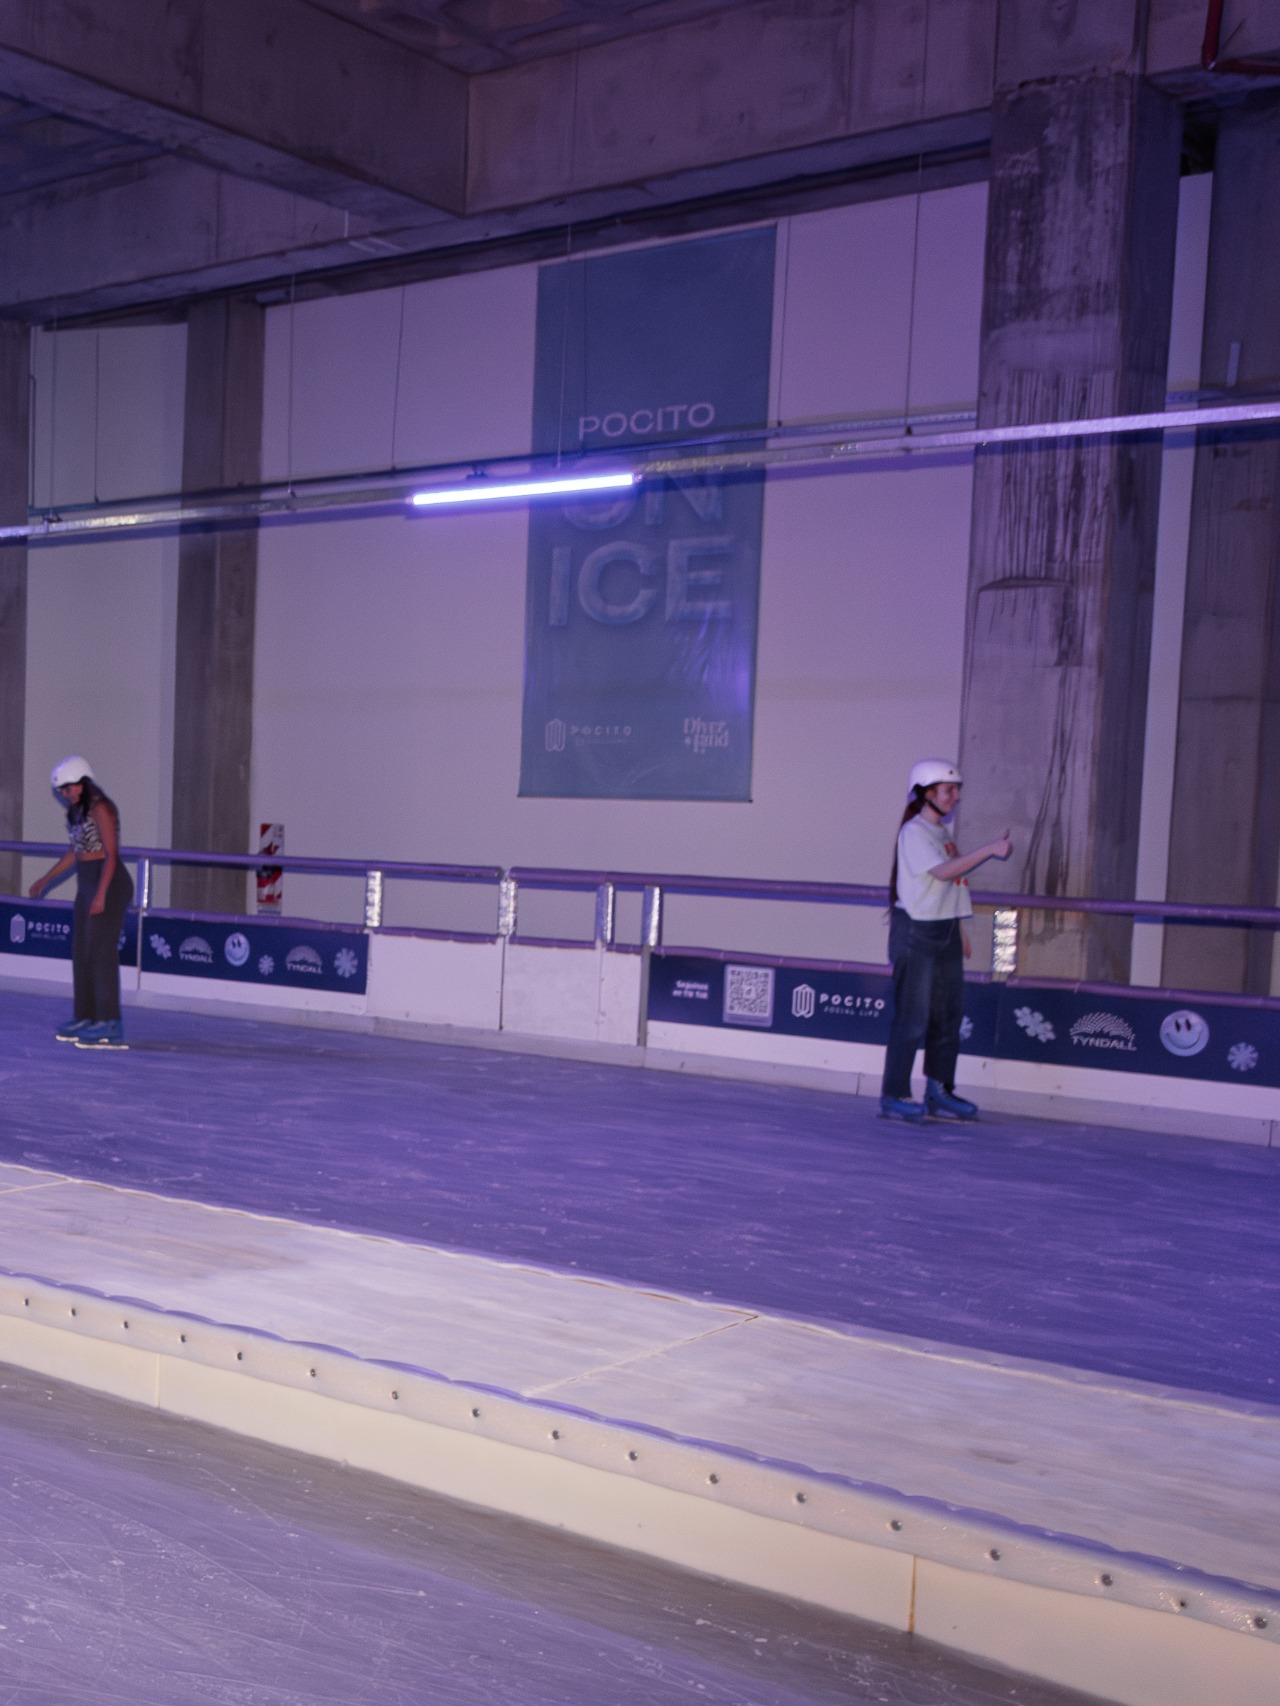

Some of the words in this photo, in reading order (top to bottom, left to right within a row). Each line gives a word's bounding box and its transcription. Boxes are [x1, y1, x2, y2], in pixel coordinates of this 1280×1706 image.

[578, 402, 715, 441] POCITO
[548, 534, 736, 627] ICE
[570, 725, 632, 737] POCITO
[27, 921, 70, 934] POCITO
[819, 992, 885, 1010] POCITO
[1071, 1033, 1137, 1051] TYNDALL
